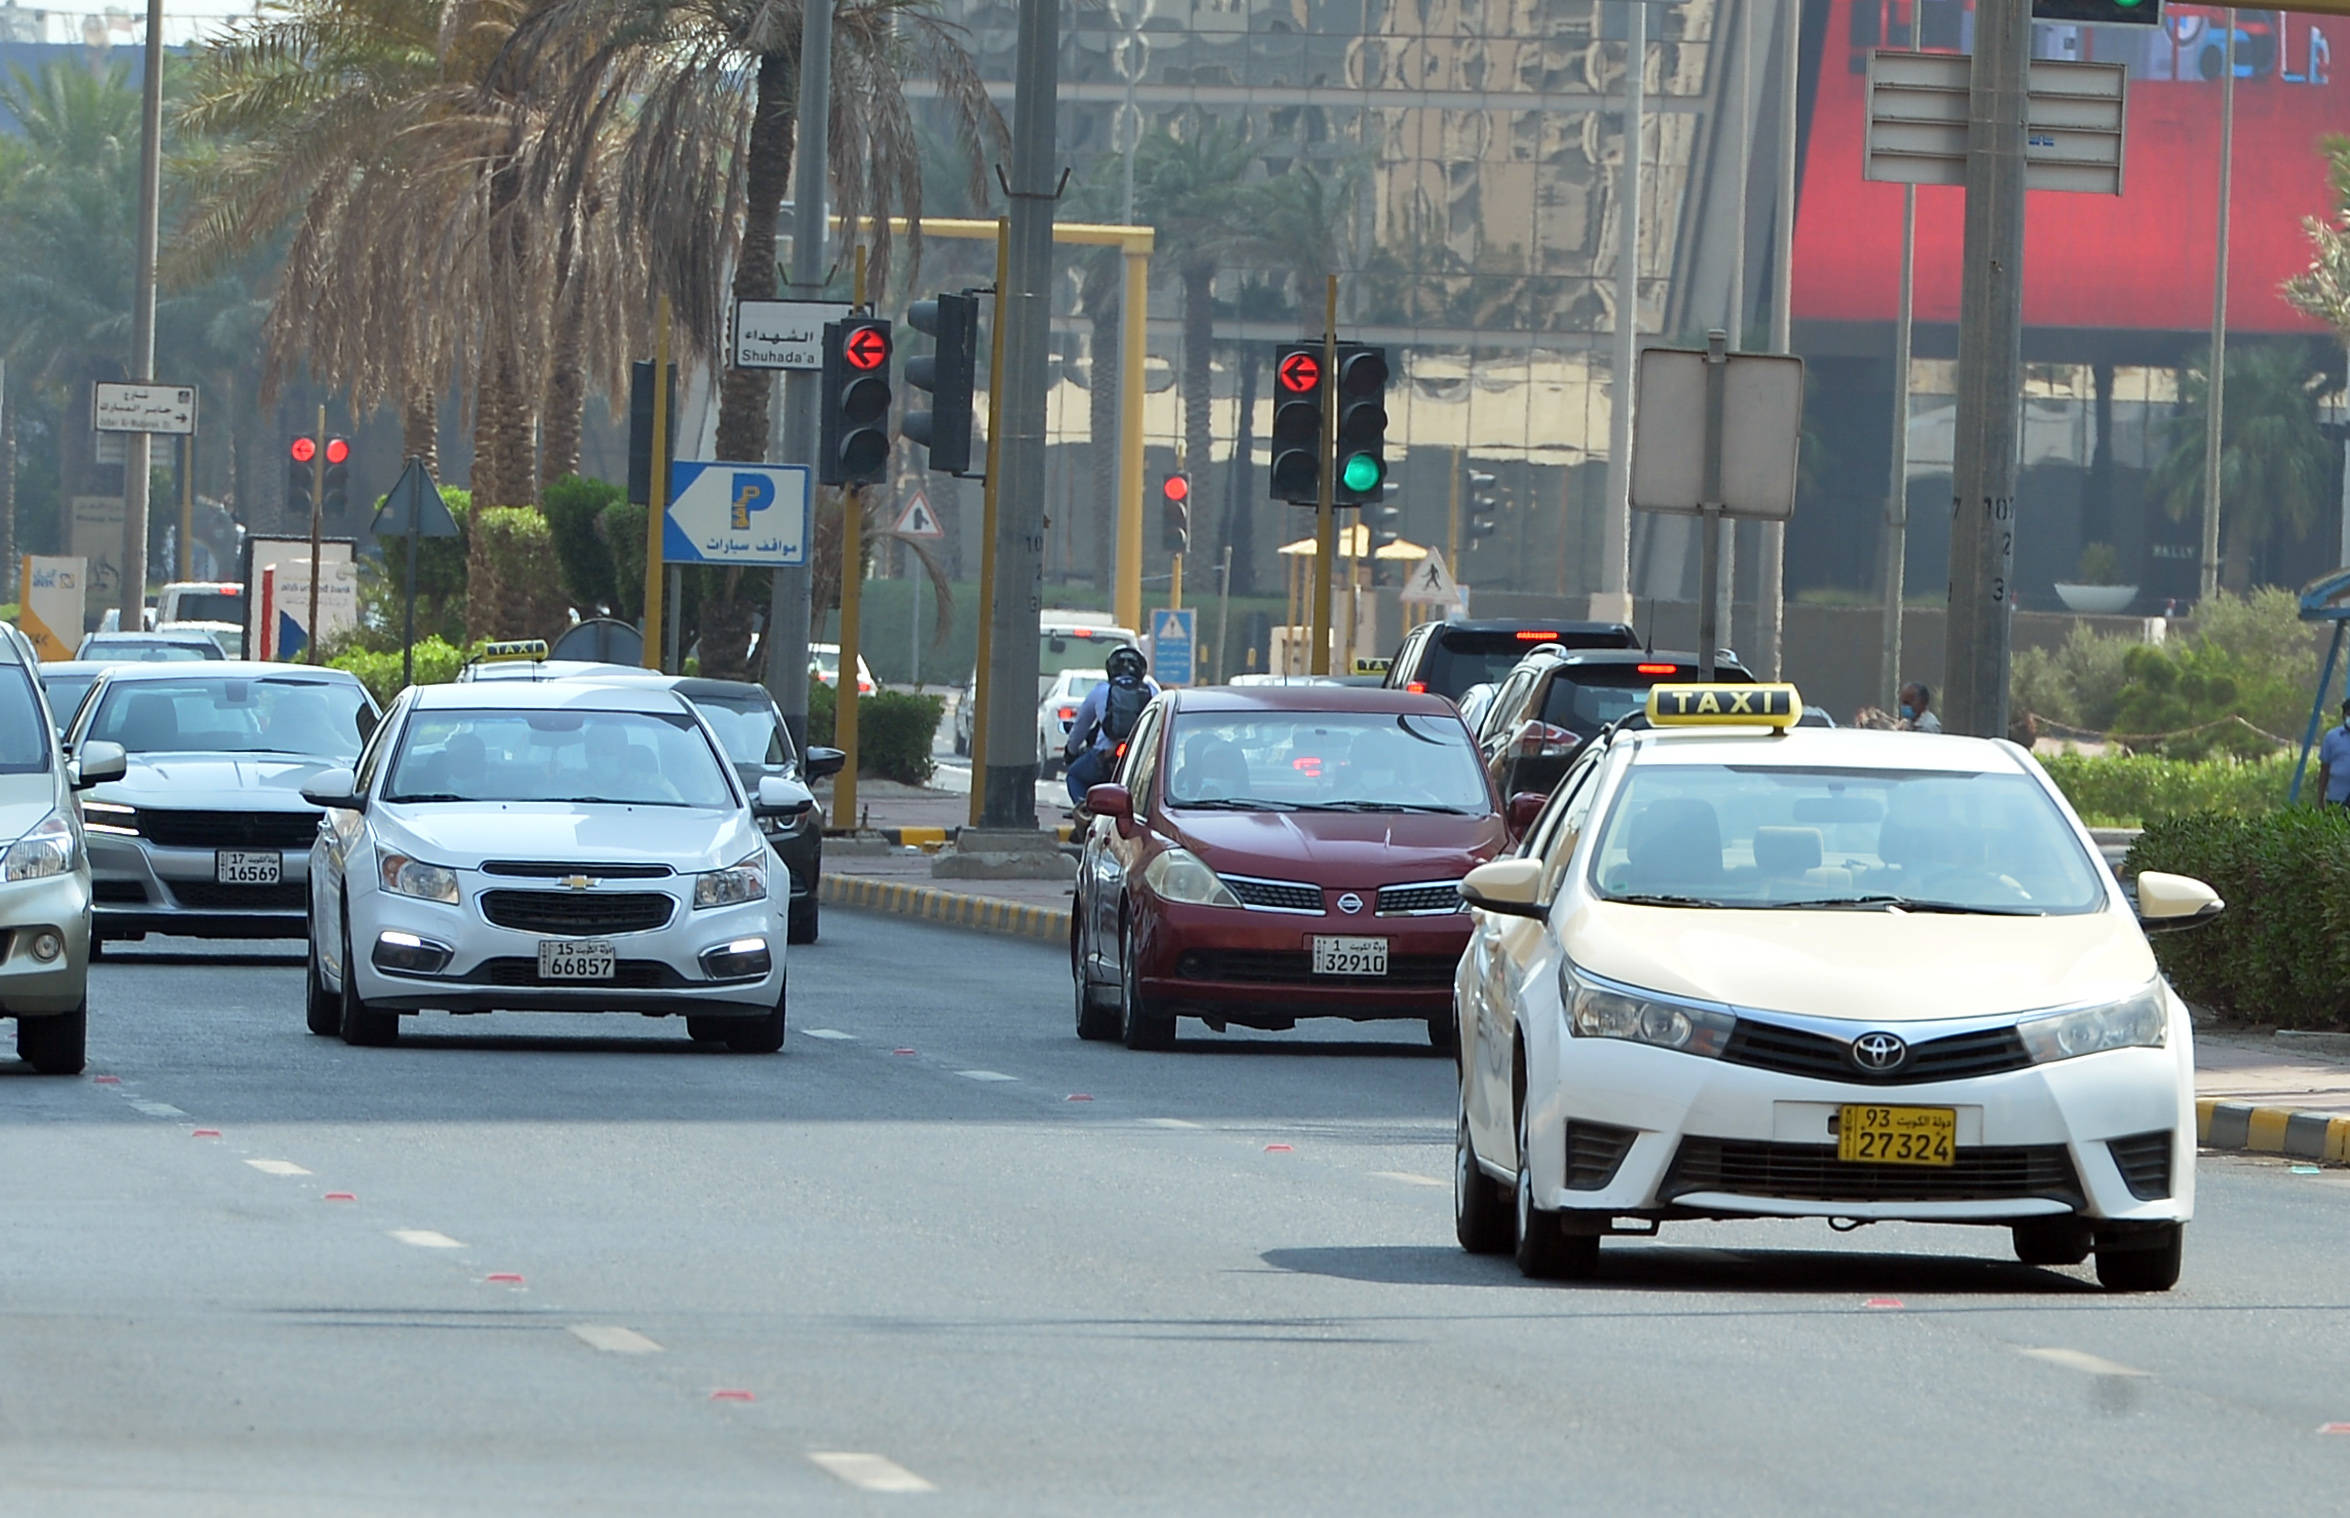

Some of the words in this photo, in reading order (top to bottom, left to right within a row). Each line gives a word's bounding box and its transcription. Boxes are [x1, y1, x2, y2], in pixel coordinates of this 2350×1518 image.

[745, 328, 813, 345] الشهداء
[706, 537, 750, 554] سيارات
[755, 537, 797, 556] مواقف
[496, 643, 536, 655] TAXI
[1672, 691, 1772, 714] TAXI
[231, 853, 245, 864] 17
[229, 866, 278, 881] 16569
[557, 943, 574, 955] 15
[1333, 939, 1341, 952] 1
[552, 958, 612, 976] 66857
[1326, 953, 1384, 972] 32910
[1866, 1108, 1891, 1128] 93
[1896, 1115, 1930, 1129] الكويت
[1932, 1116, 1951, 1129] دولة
[1858, 1131, 1949, 1161] 27324
